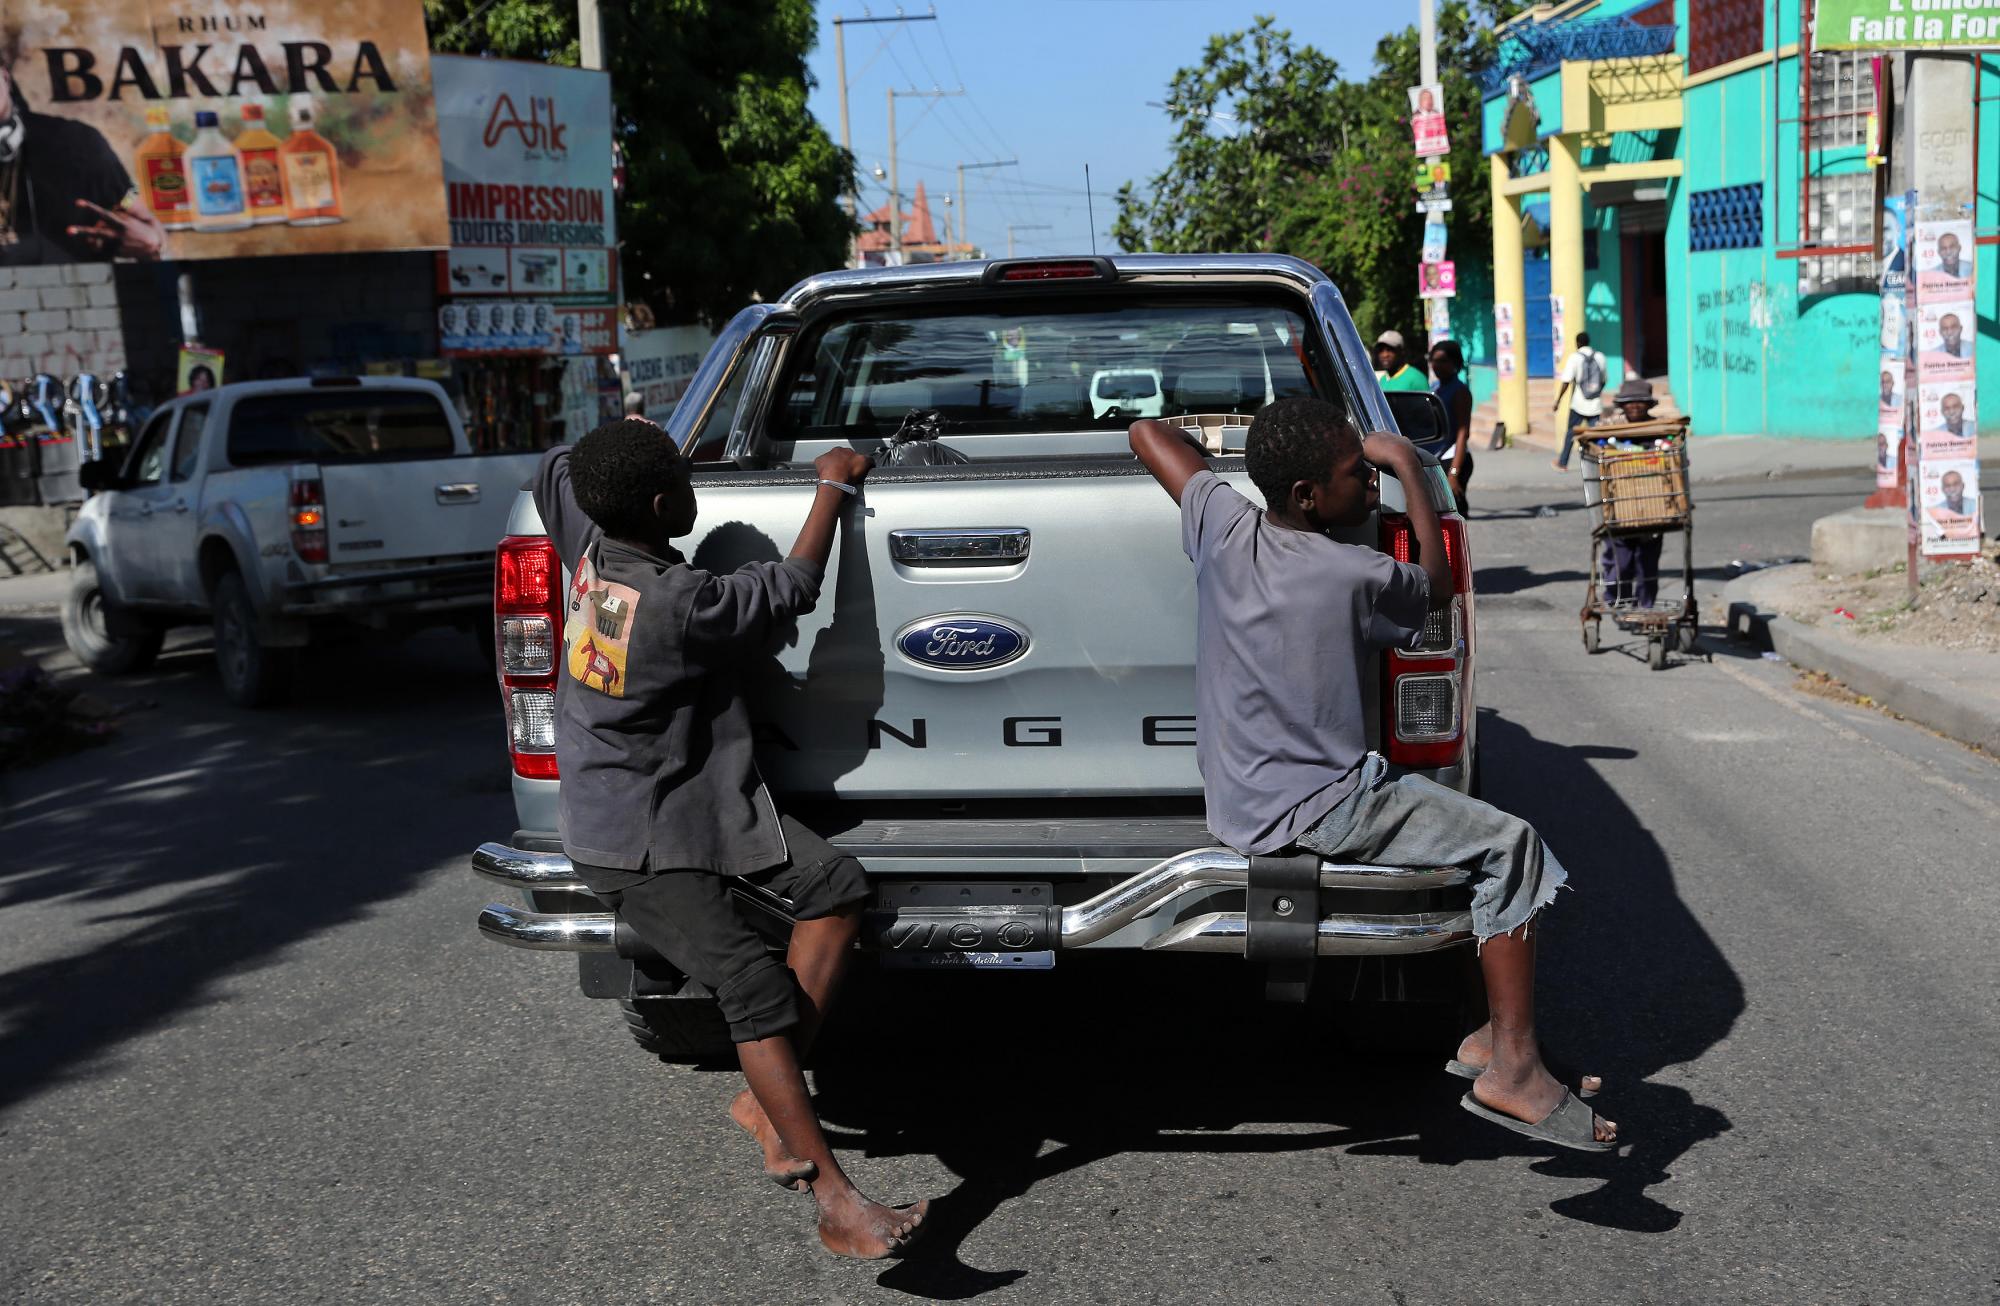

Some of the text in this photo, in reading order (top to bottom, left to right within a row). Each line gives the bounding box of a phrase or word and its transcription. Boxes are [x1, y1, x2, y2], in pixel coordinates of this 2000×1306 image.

[178, 15, 266, 32] RHUM
[1849, 15, 1906, 41] Fait
[1913, 15, 1943, 40] la
[41, 40, 398, 103] BAKARA
[449, 182, 605, 223] IMPRESSION
[450, 220, 605, 245] TOUTES DIMENSIONS
[926, 626, 996, 656] Ford
[752, 716, 1197, 750] ANGE
[887, 921, 1034, 949] VIGO
[974, 955, 1003, 965] Antilles
